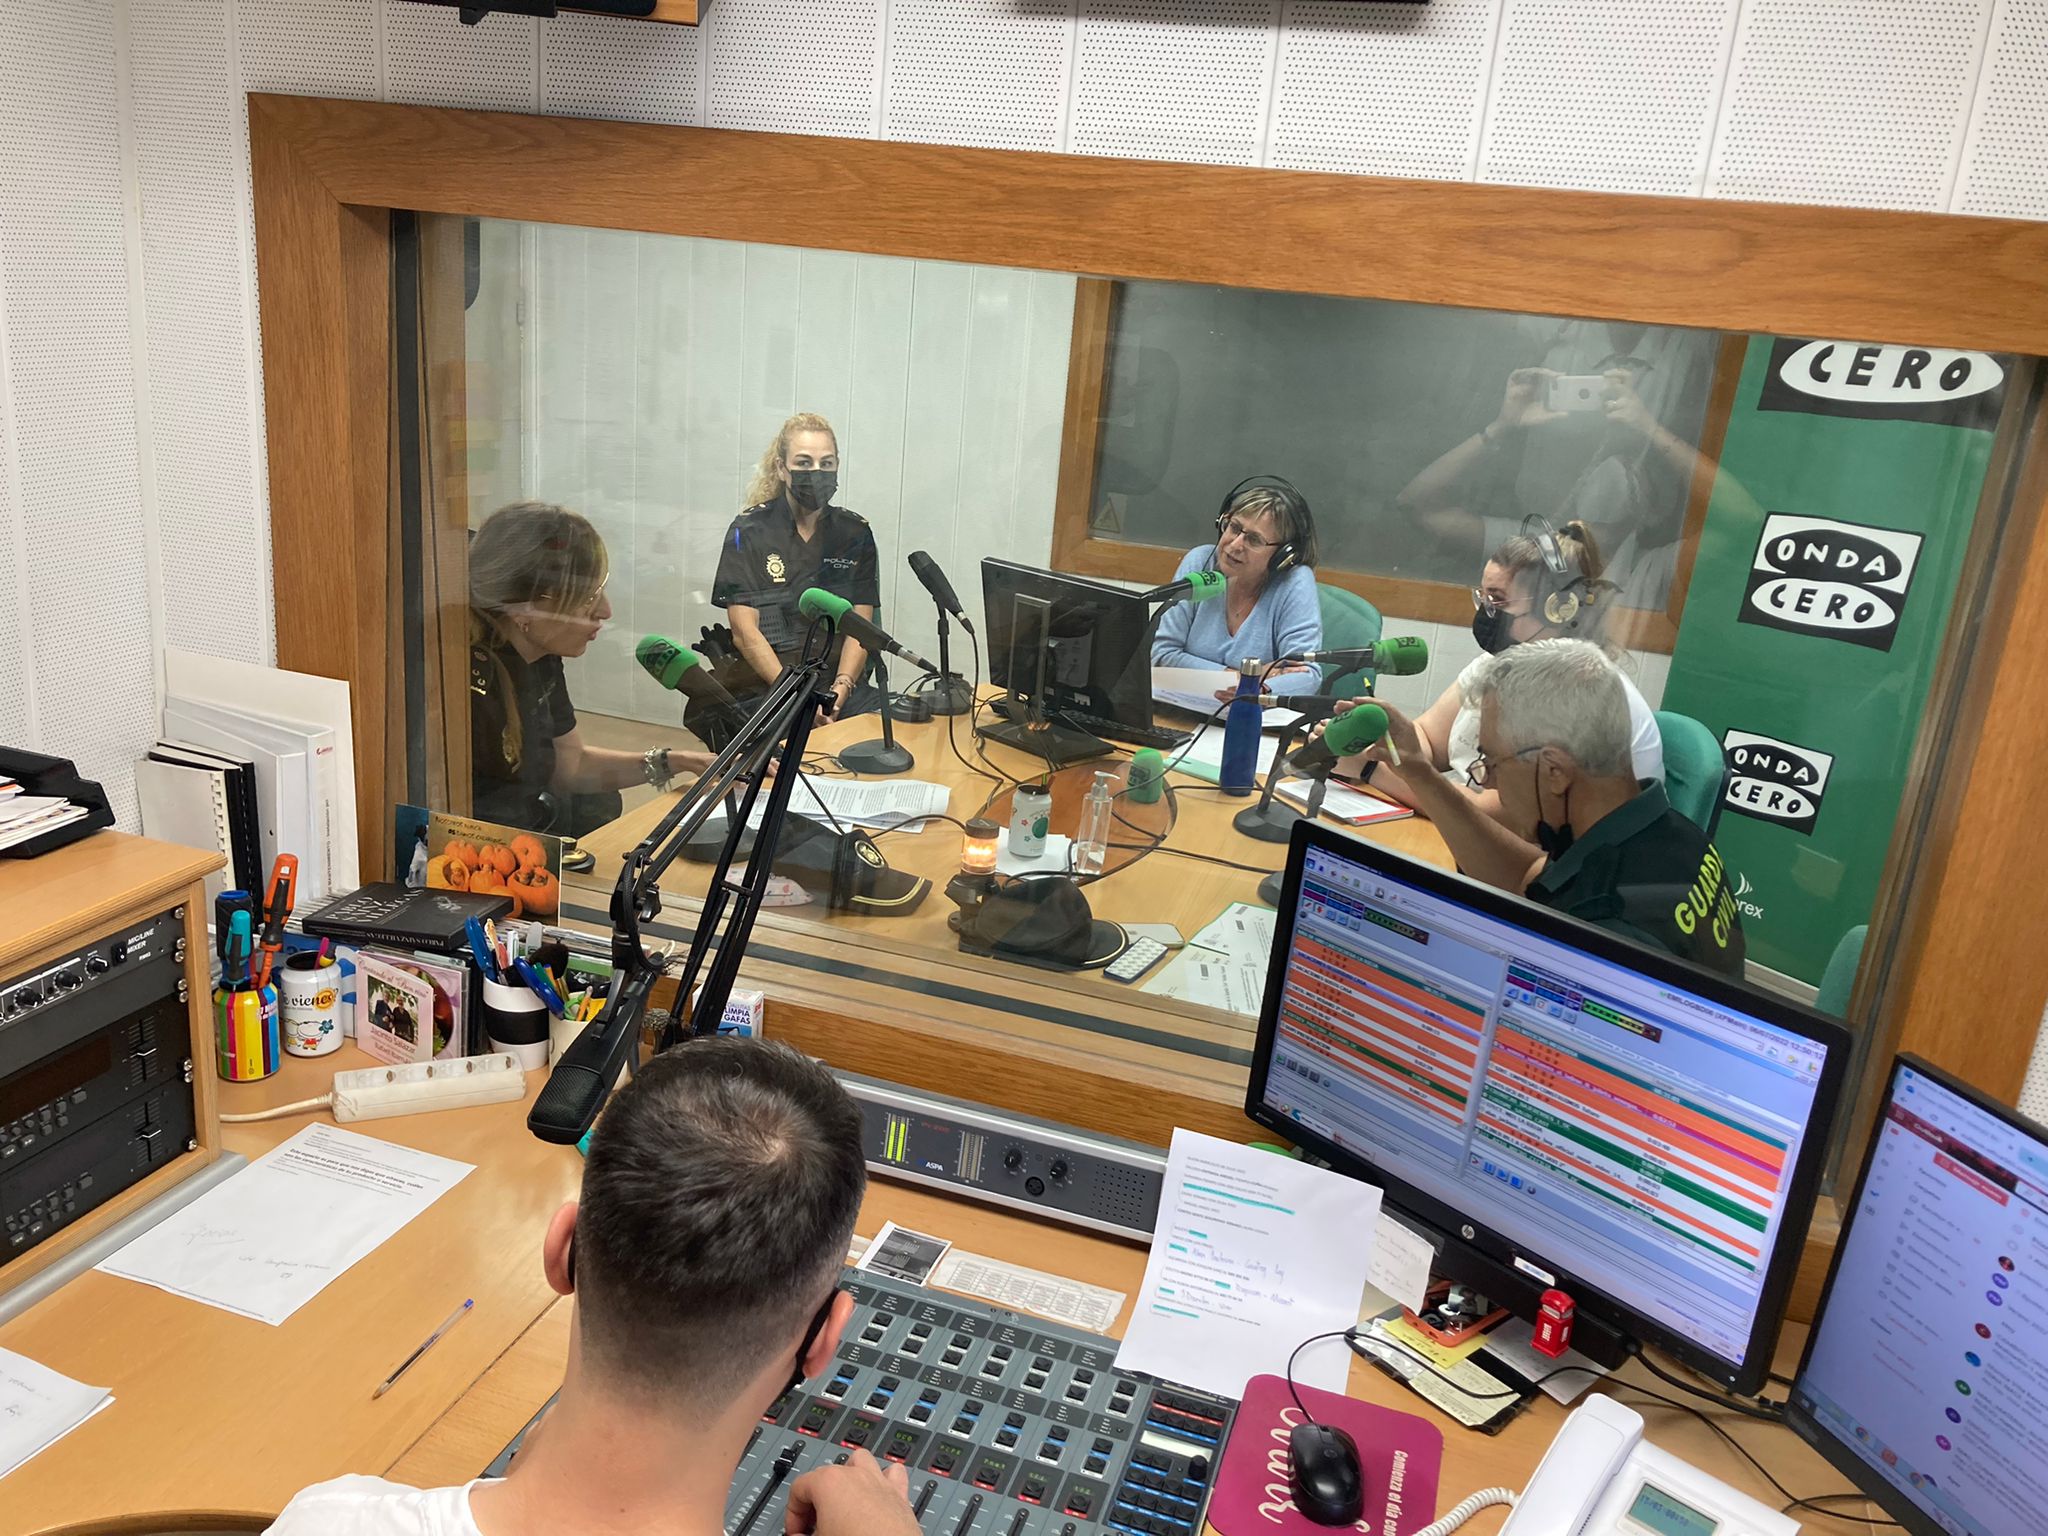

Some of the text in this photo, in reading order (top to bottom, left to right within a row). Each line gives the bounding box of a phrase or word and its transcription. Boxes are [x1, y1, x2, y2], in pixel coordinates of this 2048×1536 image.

[1809, 345, 1972, 391] CERO
[1777, 539, 1886, 577] ONDA
[1770, 584, 1875, 624] CERO
[1734, 748, 1809, 782] ONDA
[1730, 780, 1801, 814] CERO
[1675, 843, 1724, 934] GUARDI
[325, 897, 373, 920] PABLO
[724, 1014, 751, 1025] GAFAS
[725, 1006, 750, 1018] LIMPIA
[1389, 1450, 1409, 1492] Comienza
[1387, 1492, 1403, 1504] el
